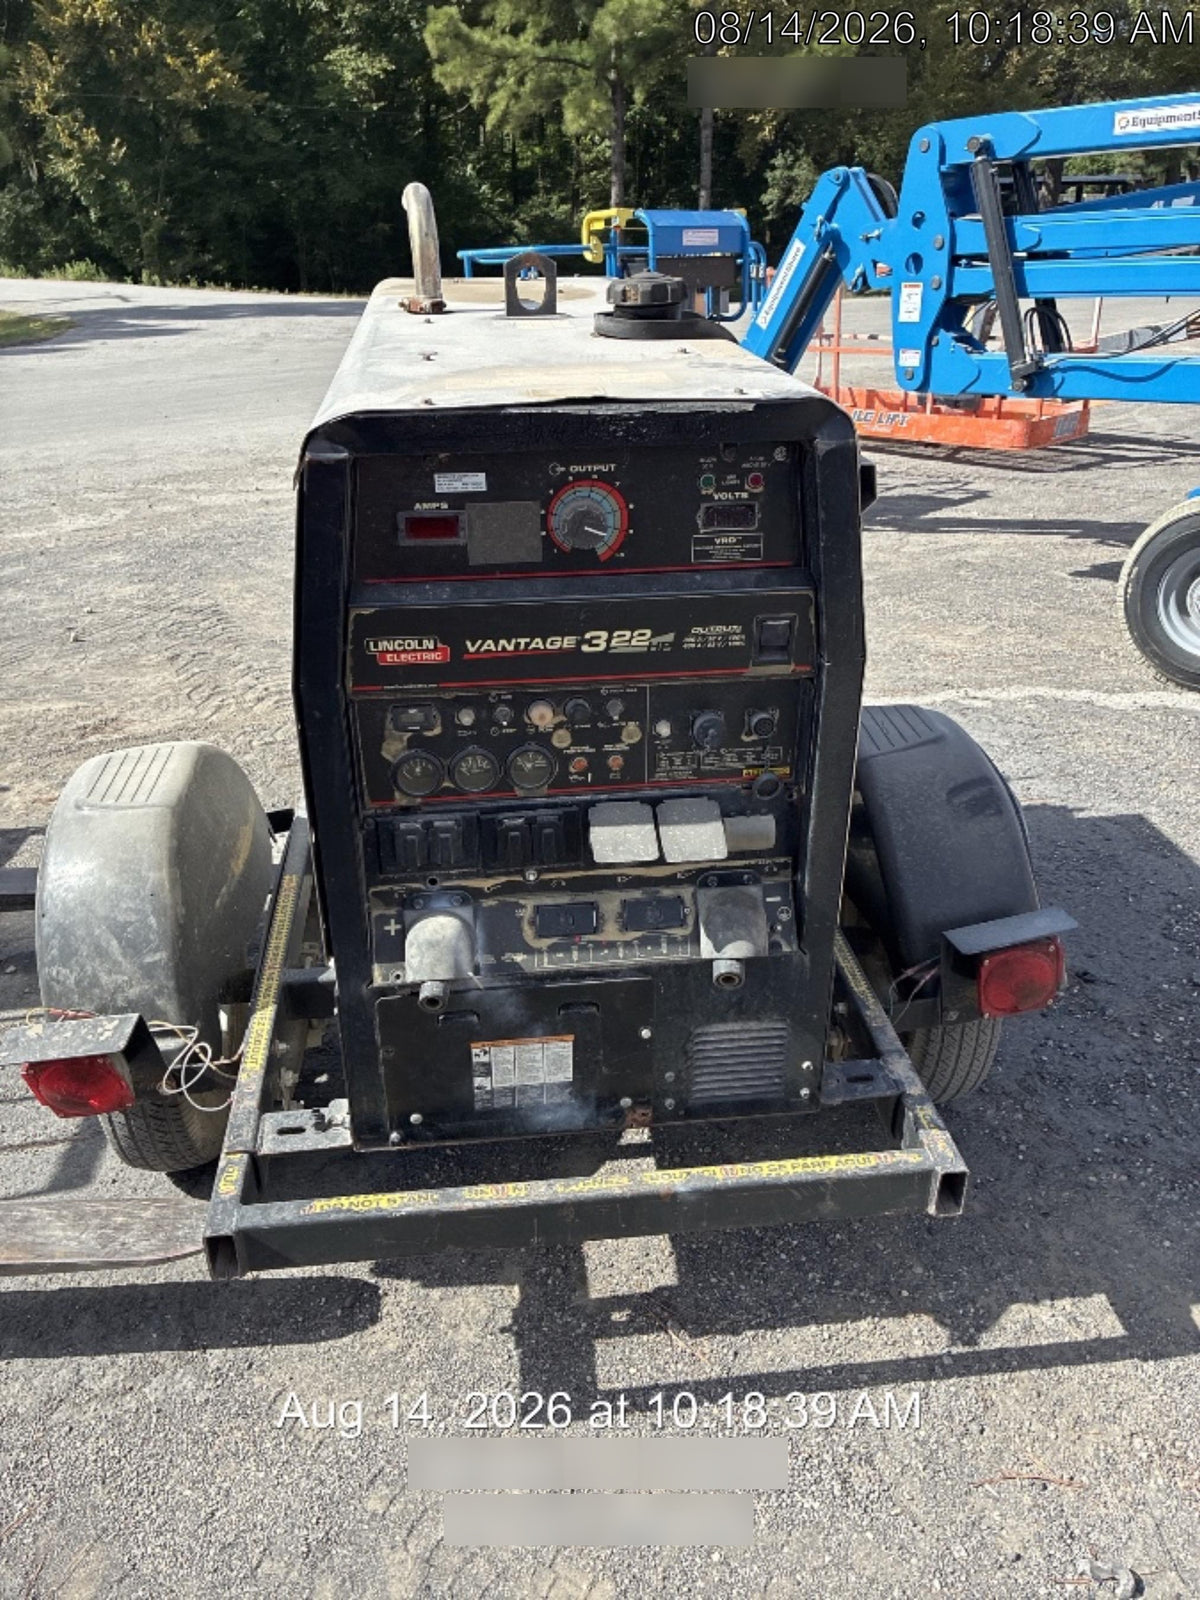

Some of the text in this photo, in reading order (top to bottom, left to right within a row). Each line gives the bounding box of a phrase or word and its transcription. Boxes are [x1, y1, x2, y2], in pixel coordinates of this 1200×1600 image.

[569, 463, 616, 473] OUTPUT
[713, 492, 749, 500] VOLTS
[414, 502, 449, 511] AMPS
[368, 638, 436, 652] LINCOLN
[465, 636, 578, 653] VANTAGE
[580, 628, 653, 653] 322
[385, 651, 443, 663] ELECTRIC
